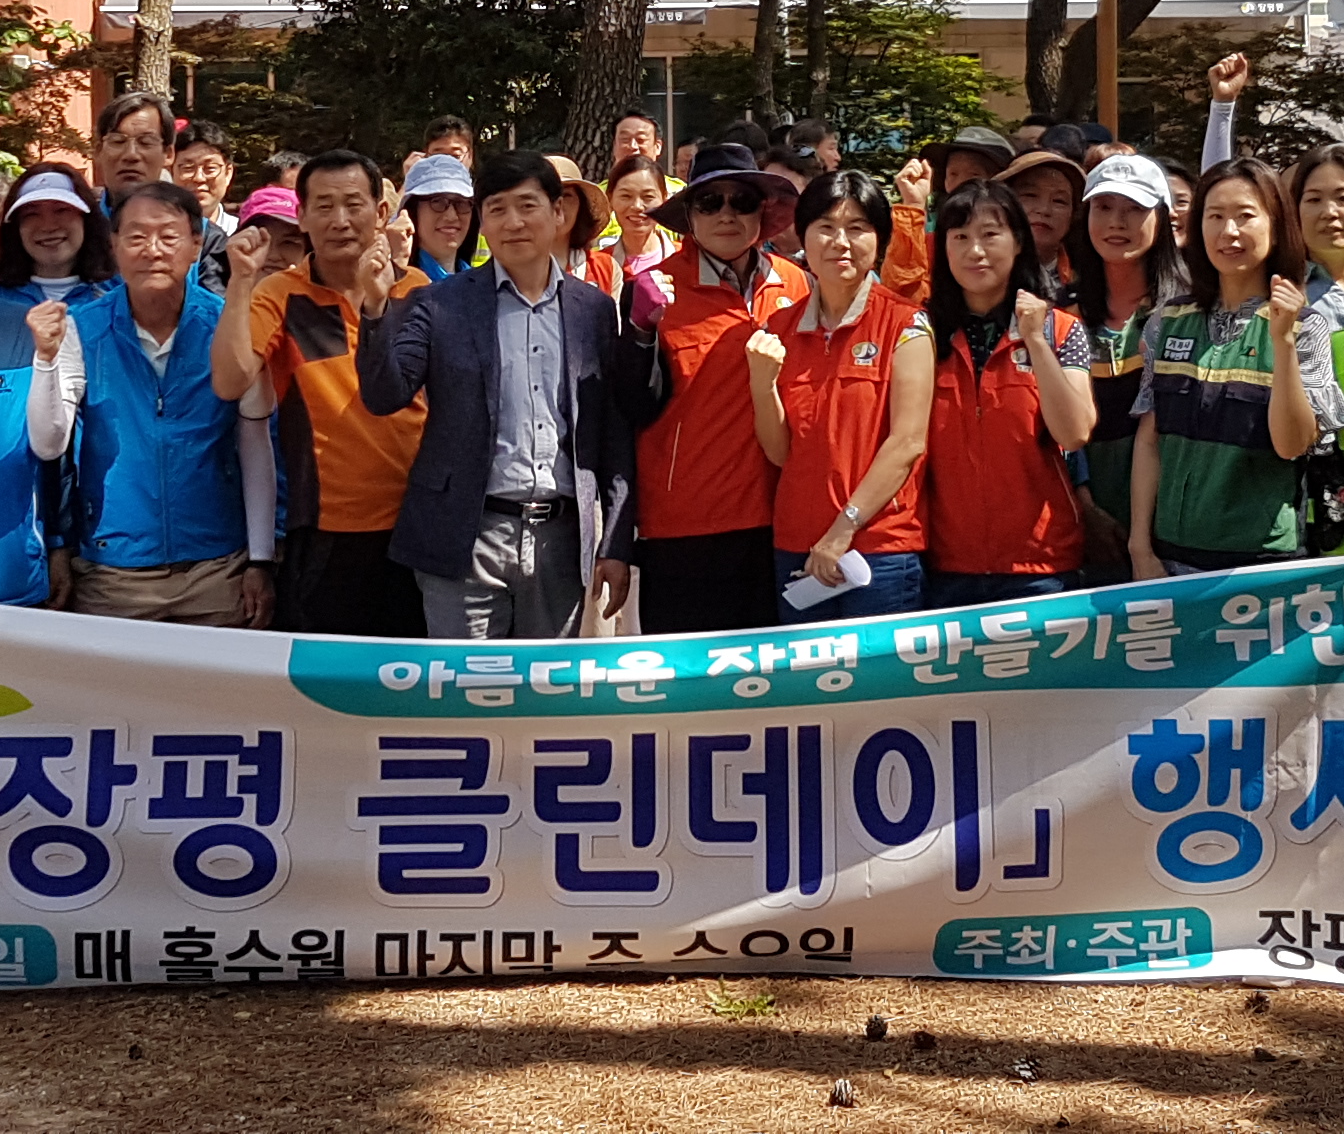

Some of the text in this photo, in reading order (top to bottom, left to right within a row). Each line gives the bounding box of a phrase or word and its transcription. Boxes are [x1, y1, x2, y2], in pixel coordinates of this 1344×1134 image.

[377, 650, 675, 707] 아름다운
[706, 632, 862, 699] 장평
[893, 598, 1182, 685] 만들기를
[74, 928, 133, 983] 매
[159, 925, 347, 983] 홀수월
[374, 928, 563, 978] 마지막
